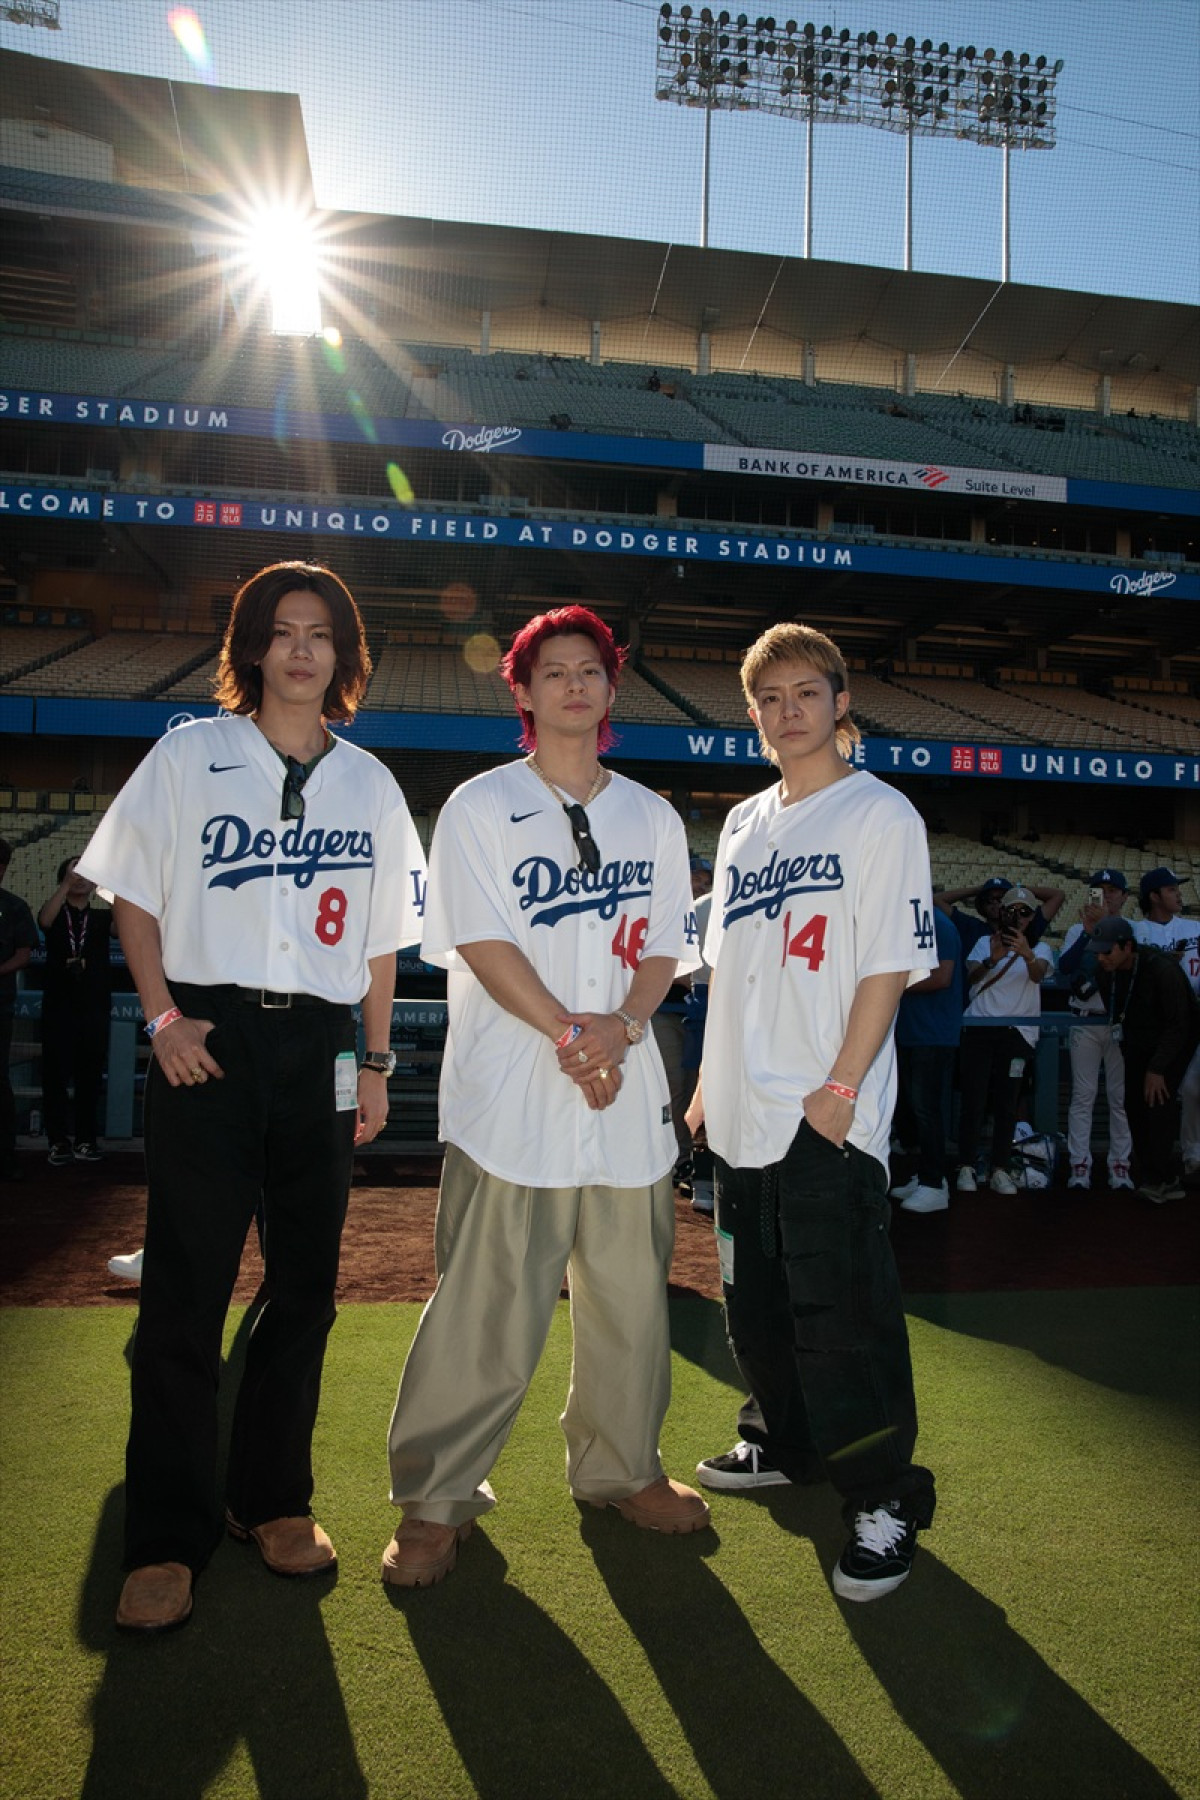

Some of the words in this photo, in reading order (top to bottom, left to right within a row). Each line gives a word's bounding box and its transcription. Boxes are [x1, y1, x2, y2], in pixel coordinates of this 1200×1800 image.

[76, 401, 229, 428] STADIUM
[442, 425, 522, 453] Dodgers
[738, 457, 790, 475] BANK
[796, 462, 820, 477] OF
[824, 464, 908, 486] AMERICA
[965, 479, 998, 493] Suite
[1002, 482, 1035, 497] Level
[0, 491, 115, 517] LCOME
[136, 500, 175, 520] TO
[260, 508, 390, 534] UNIQLO
[411, 518, 499, 539] FIELD
[518, 525, 553, 543] AT
[572, 528, 699, 555] DODGER
[718, 539, 853, 566] STADIUM
[1109, 570, 1177, 597] Dodgers
[687, 734, 867, 763] WELE
[890, 746, 932, 767] TO
[1020, 753, 1154, 780] UNIQLO
[1174, 762, 1200, 782] FI
[201, 814, 373, 891] Dodgers
[511, 855, 654, 928] Dodger
[722, 849, 844, 931] Dodgers
[314, 886, 348, 946] 8
[908, 898, 935, 949] LA
[781, 910, 828, 972] 14
